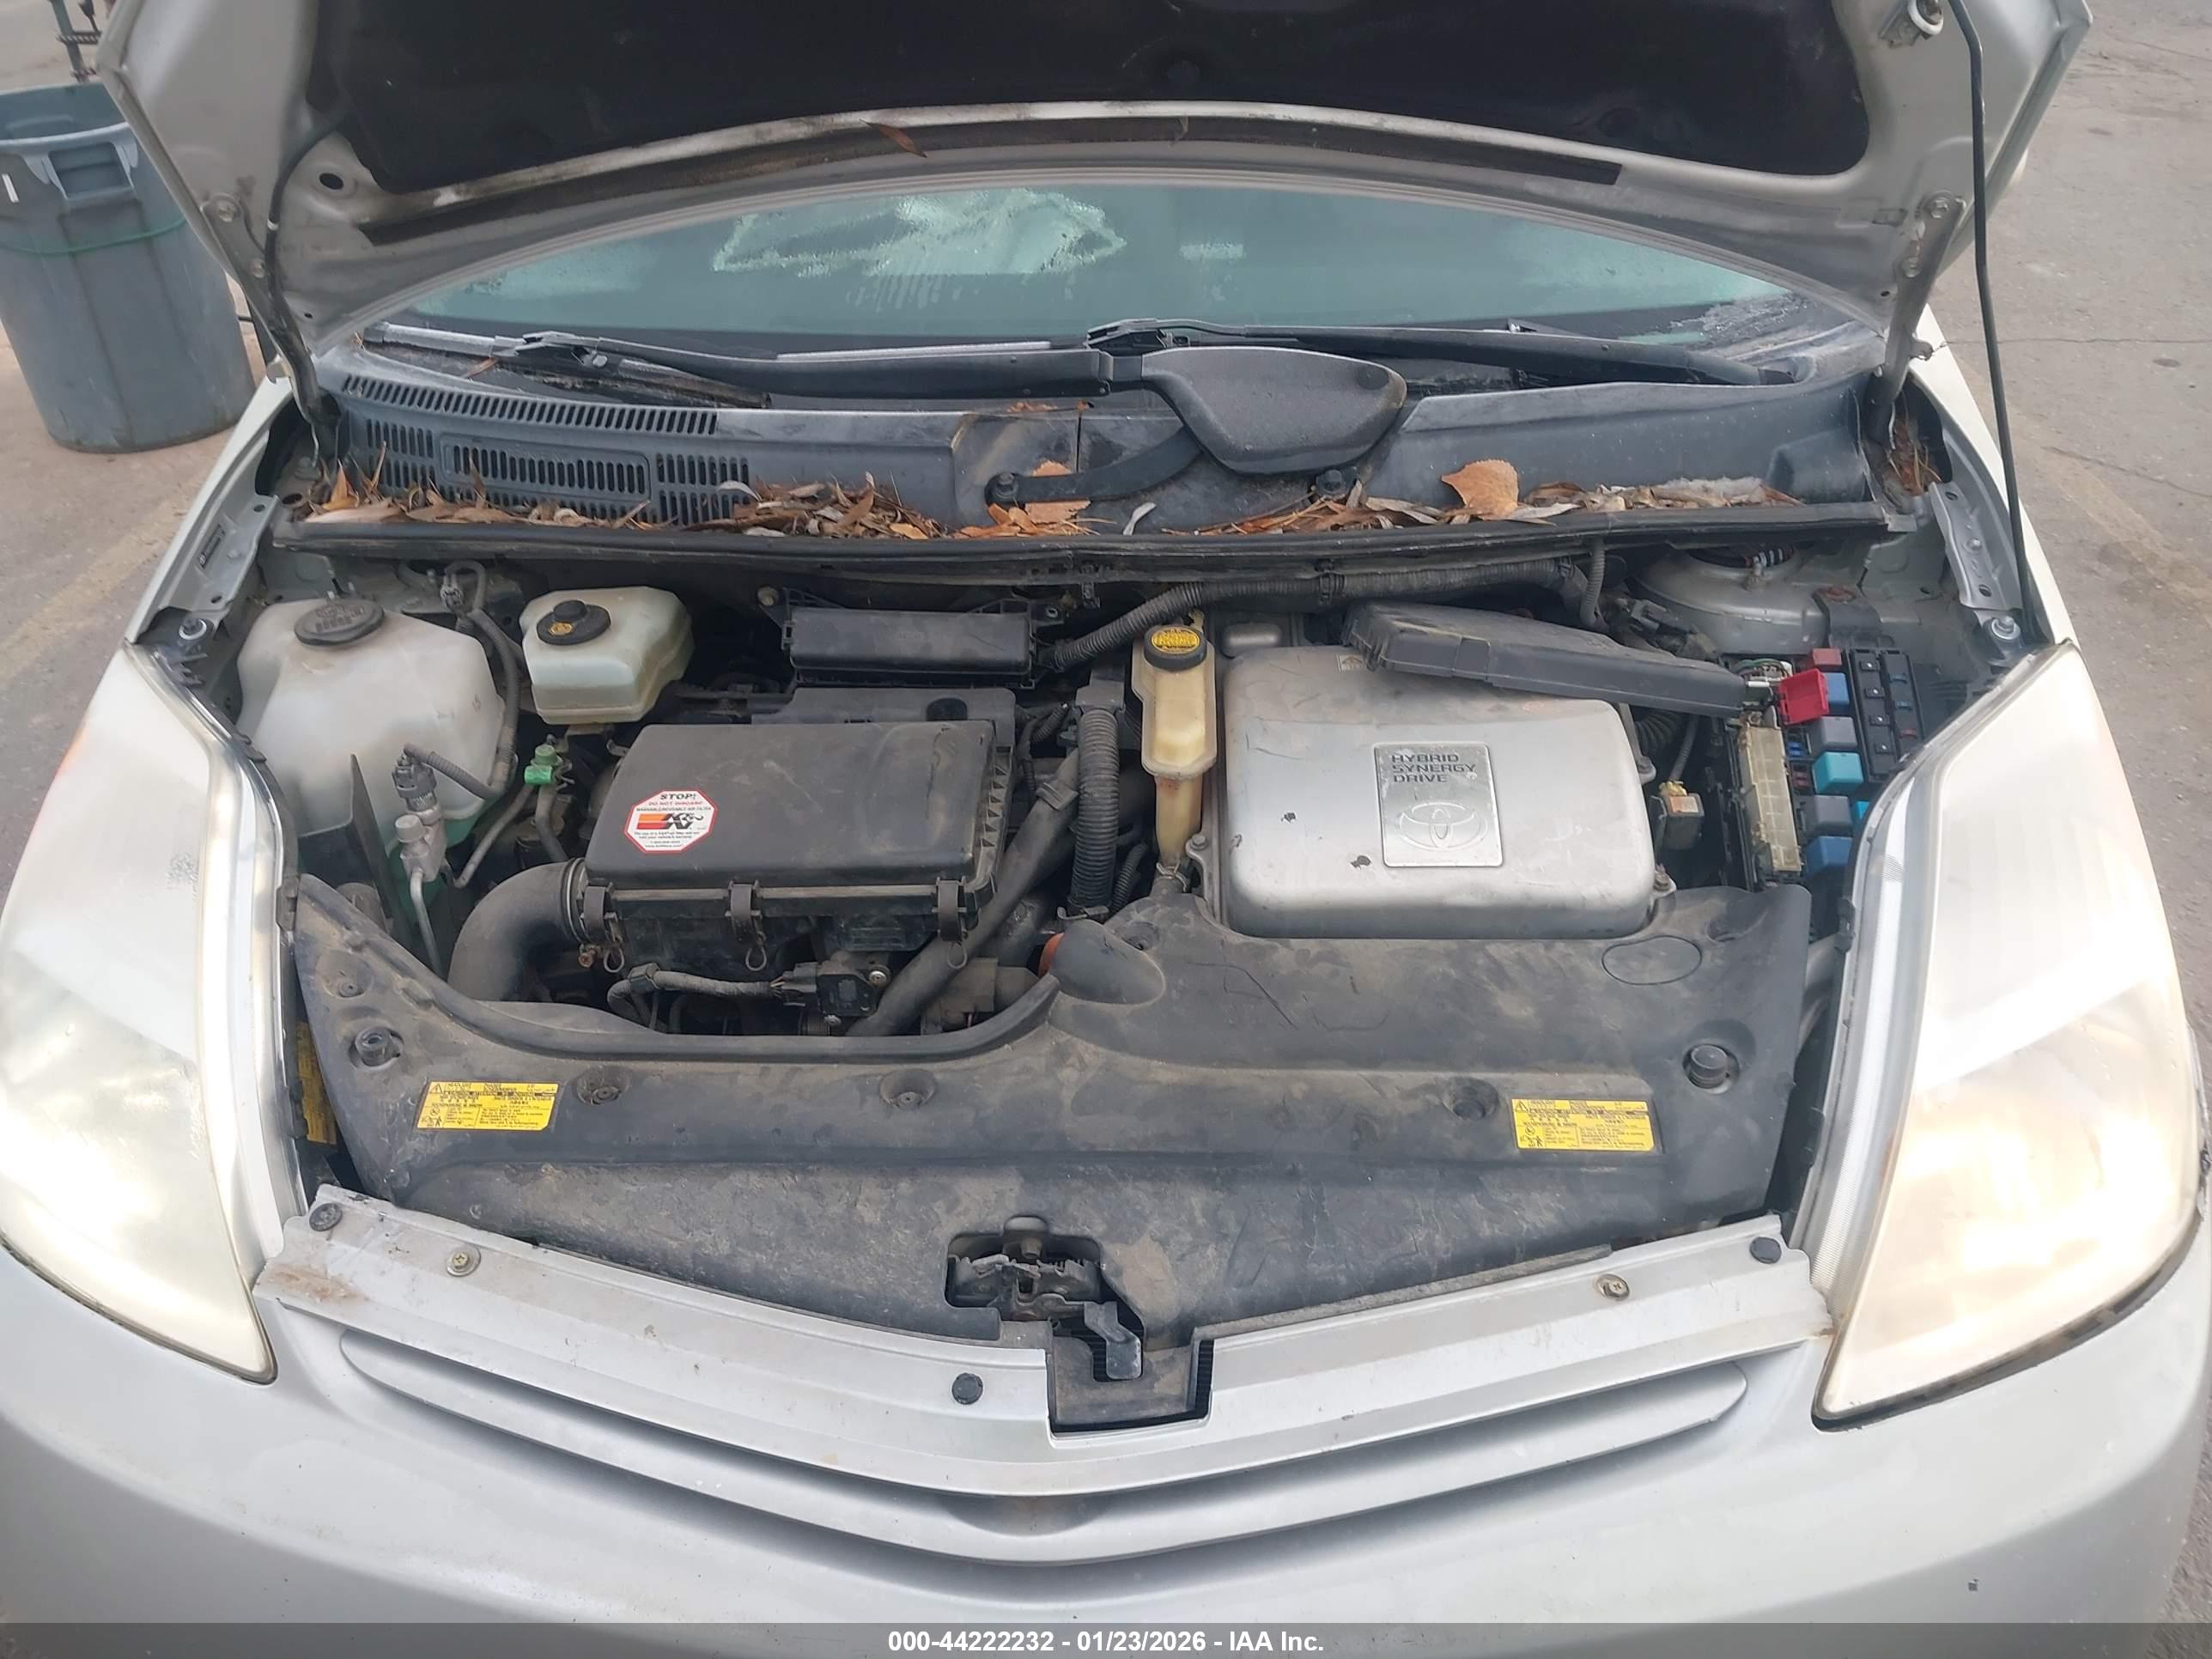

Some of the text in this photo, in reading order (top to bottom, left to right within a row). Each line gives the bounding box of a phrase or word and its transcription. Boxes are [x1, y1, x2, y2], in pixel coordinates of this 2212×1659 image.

[1391, 754, 1459, 763] HYBRID
[1392, 763, 1477, 773] SYNERGY
[1394, 774, 1449, 782] DRIVE
